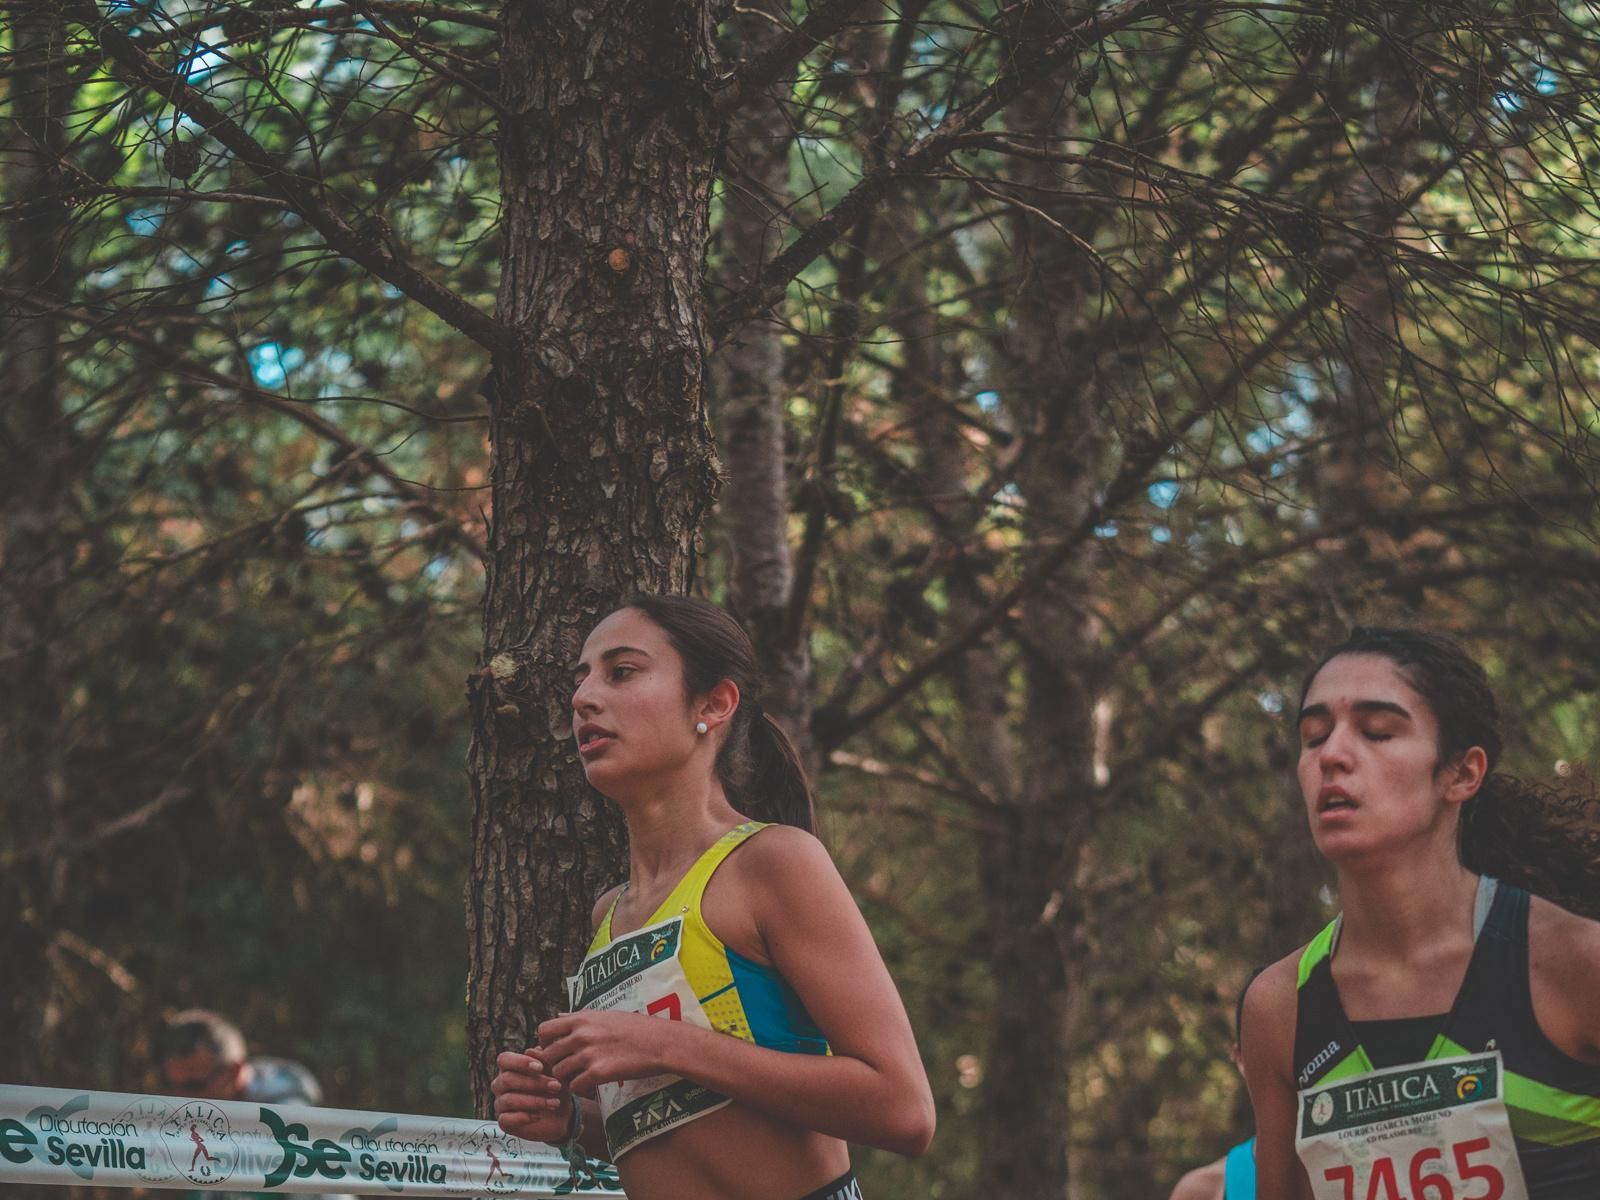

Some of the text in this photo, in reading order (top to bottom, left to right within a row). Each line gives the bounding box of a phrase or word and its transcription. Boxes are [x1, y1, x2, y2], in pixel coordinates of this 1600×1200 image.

[585, 943, 641, 989] ITÁLICA
[1298, 1041, 1341, 1089] Joma
[1344, 1073, 1440, 1113] ITÁLICA
[39, 1113, 138, 1138] Diputación
[1375, 1119, 1410, 1133] GARCIA
[1411, 1109, 1453, 1125] MORENO
[47, 1135, 147, 1171] Sevilla
[350, 1134, 439, 1154] Diputación
[359, 1153, 447, 1185] Sevilla
